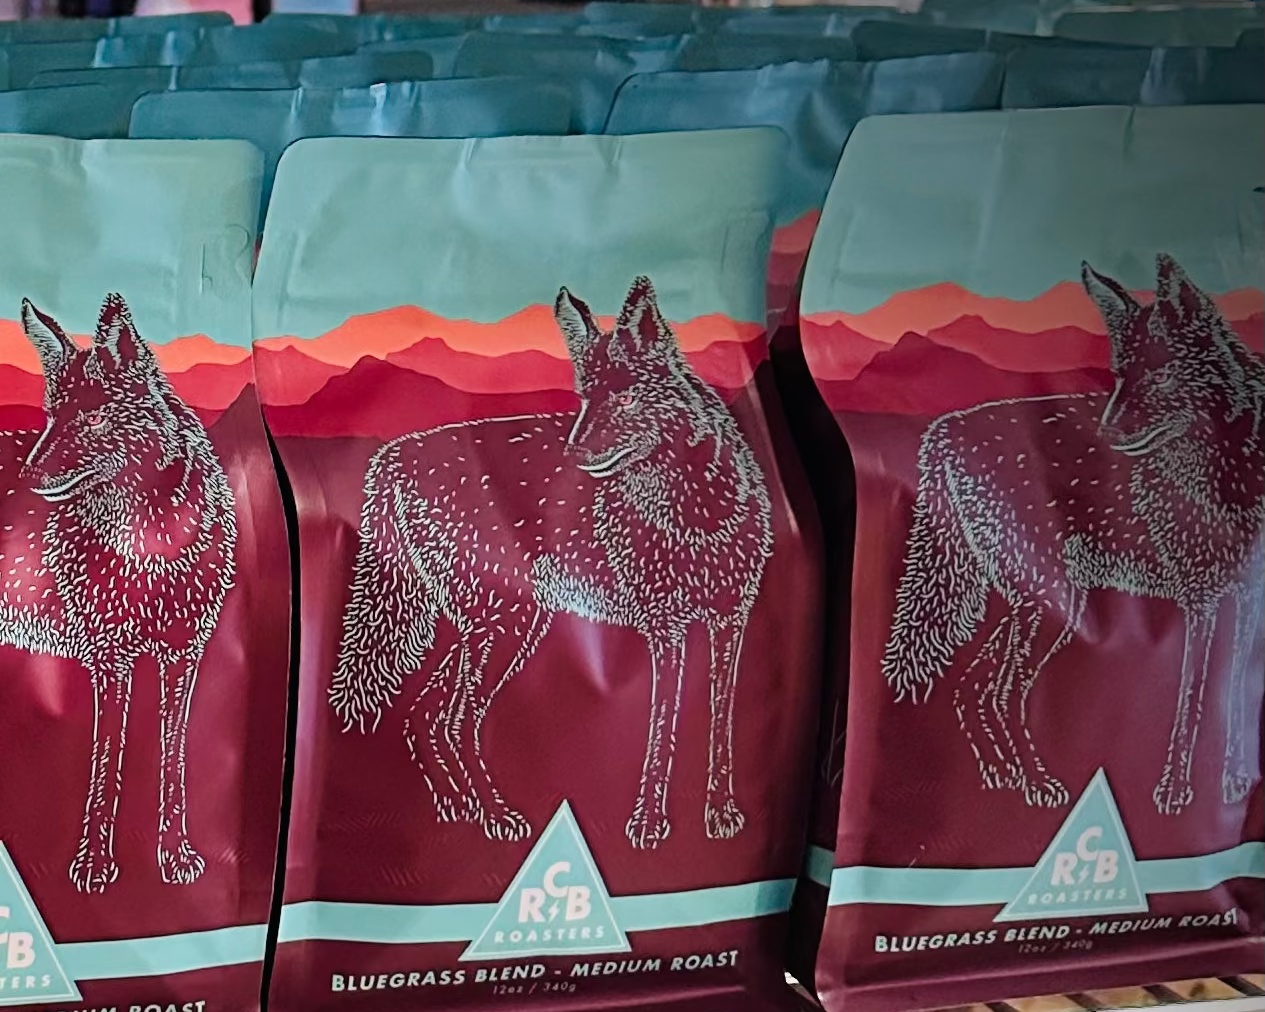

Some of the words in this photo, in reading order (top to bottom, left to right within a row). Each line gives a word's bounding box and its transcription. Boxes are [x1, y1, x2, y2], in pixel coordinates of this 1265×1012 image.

[1027, 888, 1127, 905] ROASTERS
[494, 925, 604, 944] ROASTERS
[875, 930, 998, 952] BLUEGRASS
[1004, 925, 1071, 942] BLEND
[1088, 917, 1172, 935] MEDIUM
[1178, 907, 1237, 926] ROAST
[331, 970, 466, 991] BLUEGRASS
[475, 964, 546, 982] BLEND
[570, 958, 661, 977] MEDIUM
[670, 950, 739, 971] ROAST
[543, 981, 576, 993] 340g
